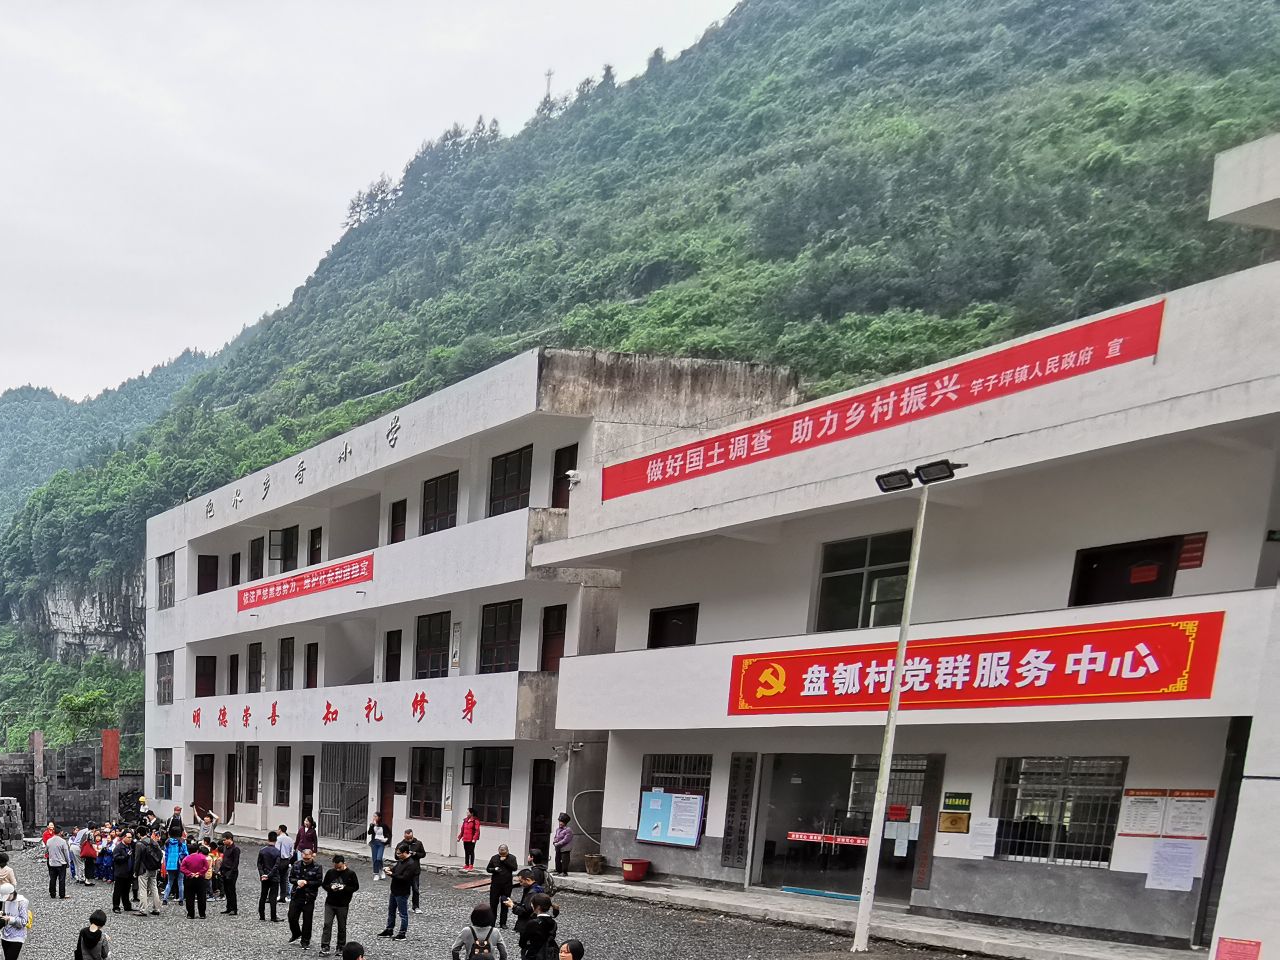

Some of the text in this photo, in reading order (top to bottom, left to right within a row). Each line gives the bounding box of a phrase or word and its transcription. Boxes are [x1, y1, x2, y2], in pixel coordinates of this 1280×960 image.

[646, 429, 772, 484] 做好国土调查
[790, 373, 961, 444] 助力乡村振兴
[1105, 337, 1124, 359] 宣
[800, 642, 1160, 697] 盘瓠村党群服务中心
[192, 688, 478, 728] 明德崇善 知礼修身
